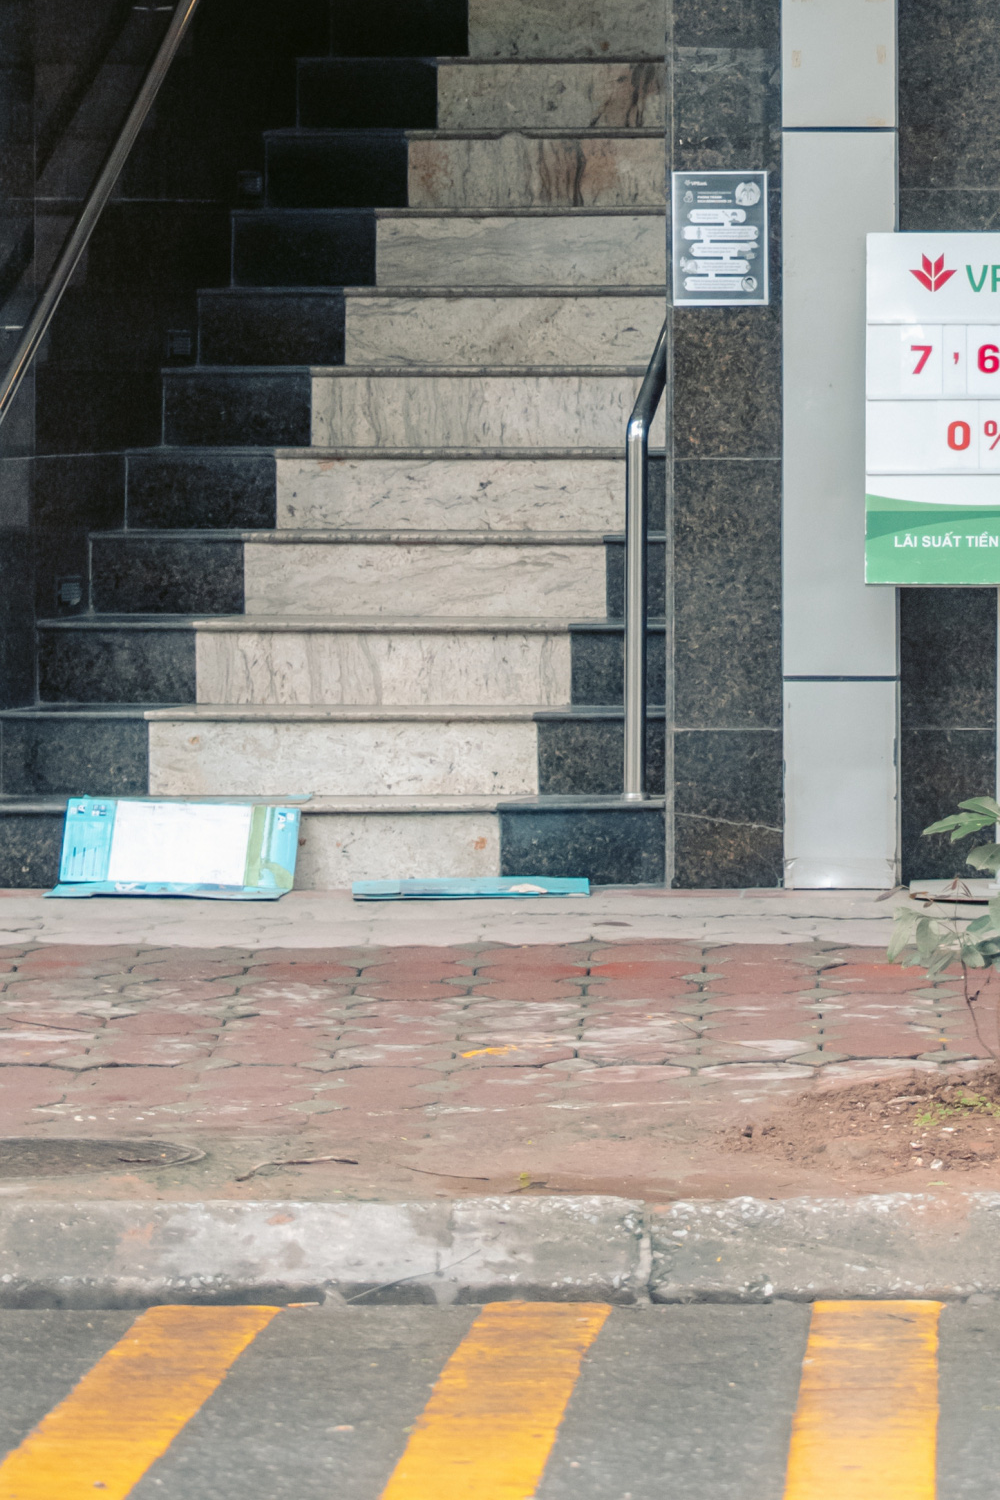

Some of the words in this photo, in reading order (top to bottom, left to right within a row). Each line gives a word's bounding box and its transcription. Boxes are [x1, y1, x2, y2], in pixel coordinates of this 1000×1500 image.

[894, 533, 918, 548] LÃI
[922, 531, 962, 548] SUẤT
[966, 531, 999, 548] TIỀN
